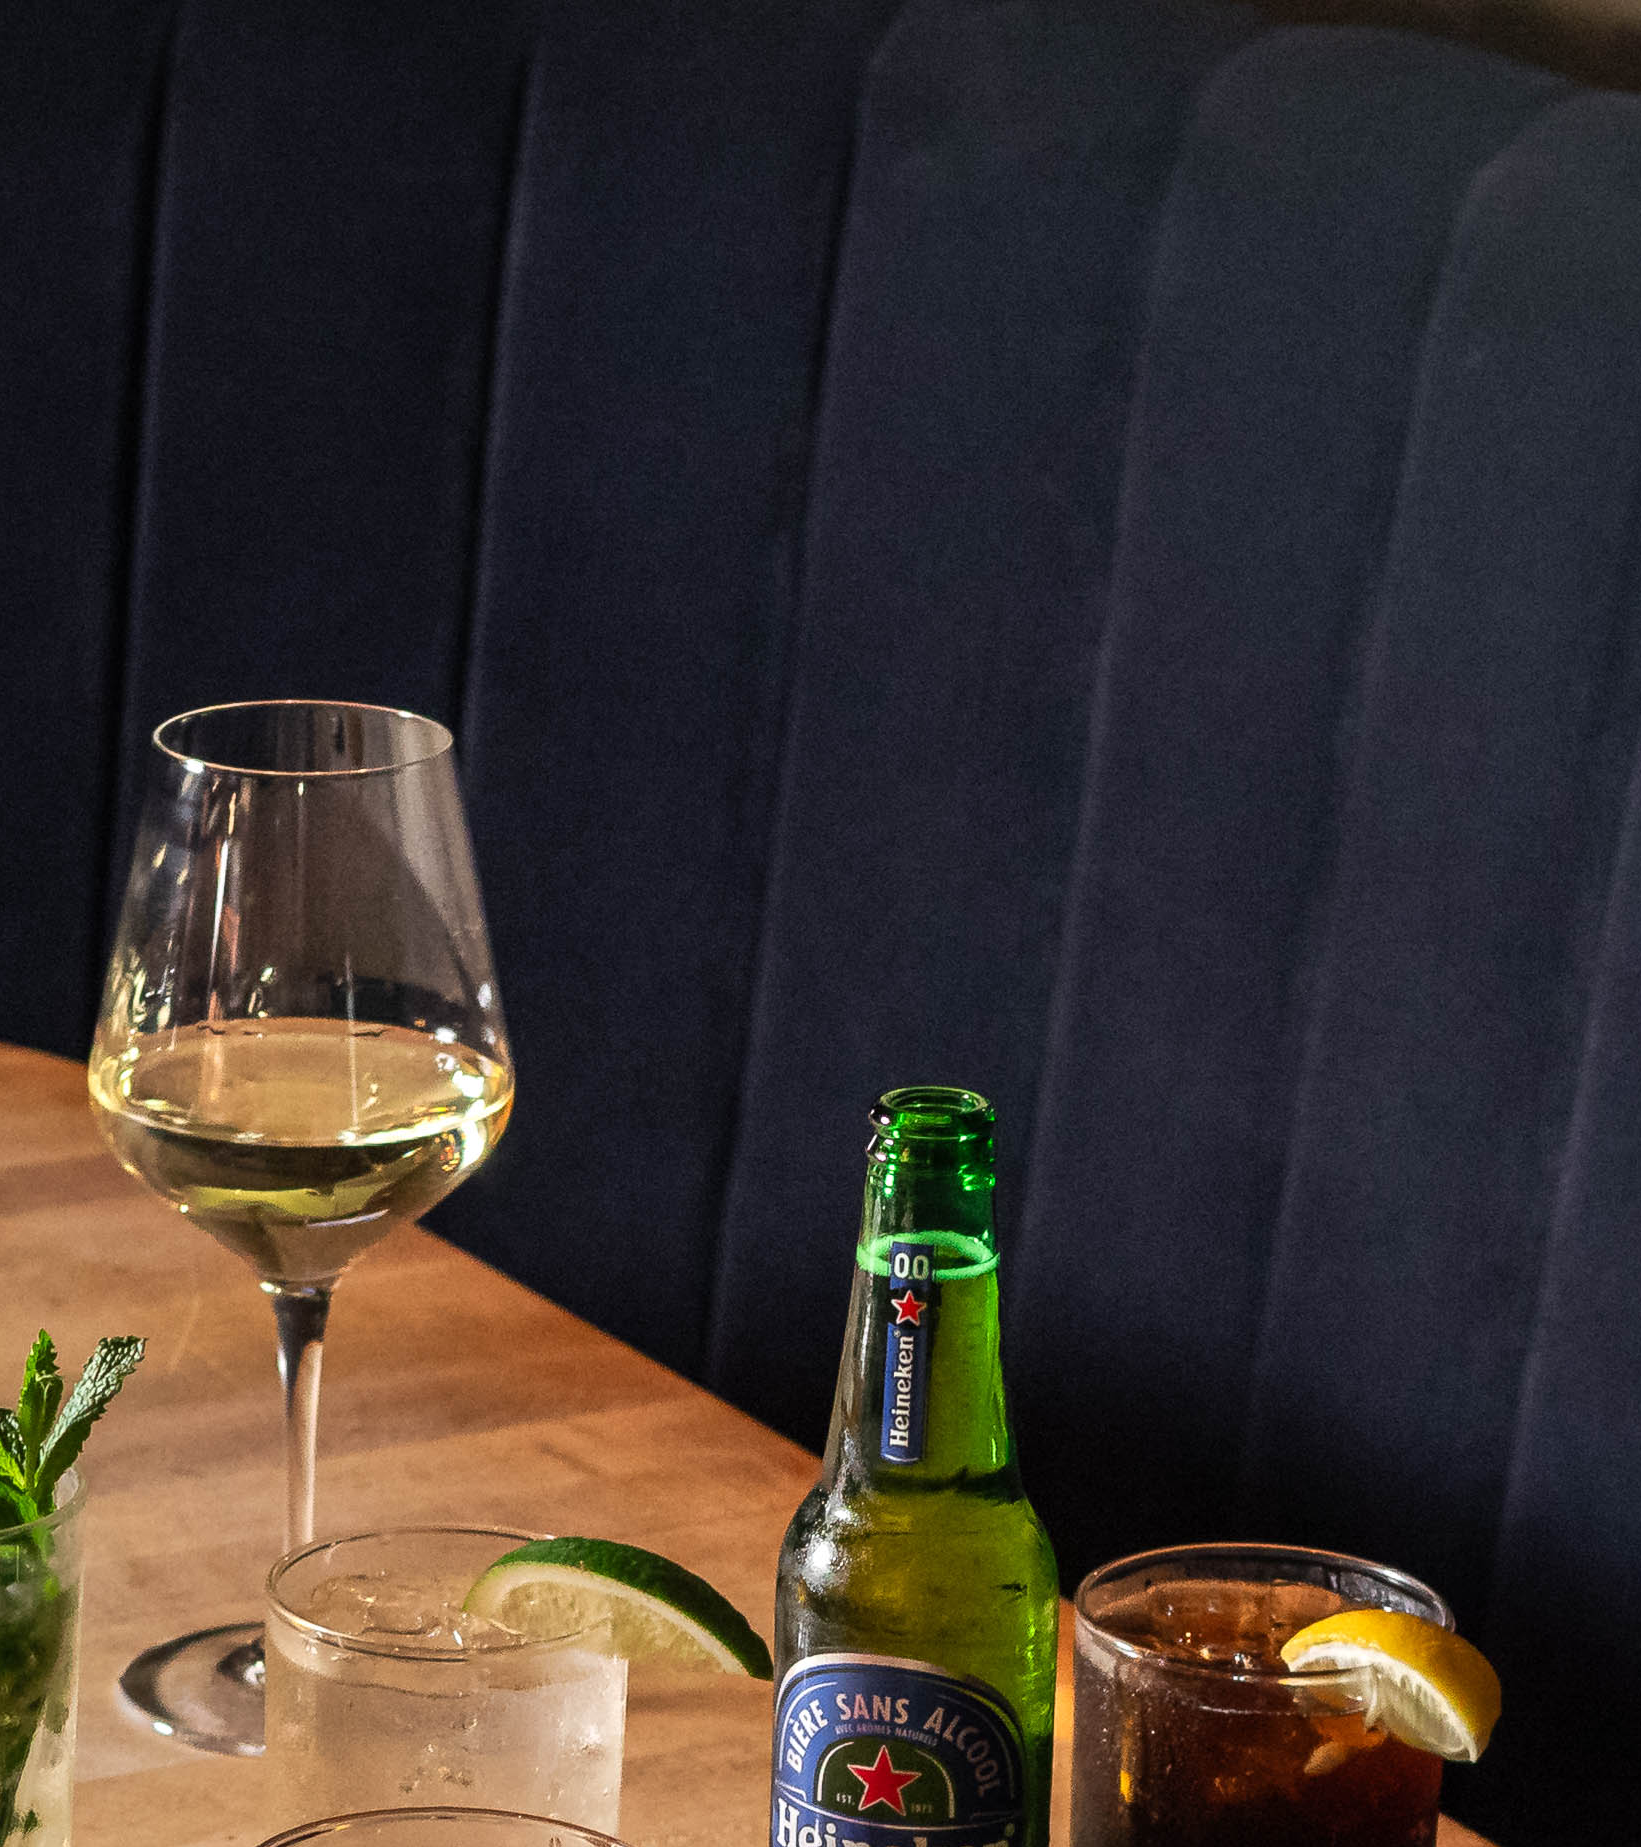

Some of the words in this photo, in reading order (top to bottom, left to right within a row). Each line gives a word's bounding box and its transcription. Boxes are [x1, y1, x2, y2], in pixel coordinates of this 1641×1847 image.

[889, 1335, 914, 1448] Heineken
[785, 1698, 829, 1774] BIÈRE
[835, 1693, 910, 1725] SANS
[923, 1707, 1002, 1798] ALCOOL
